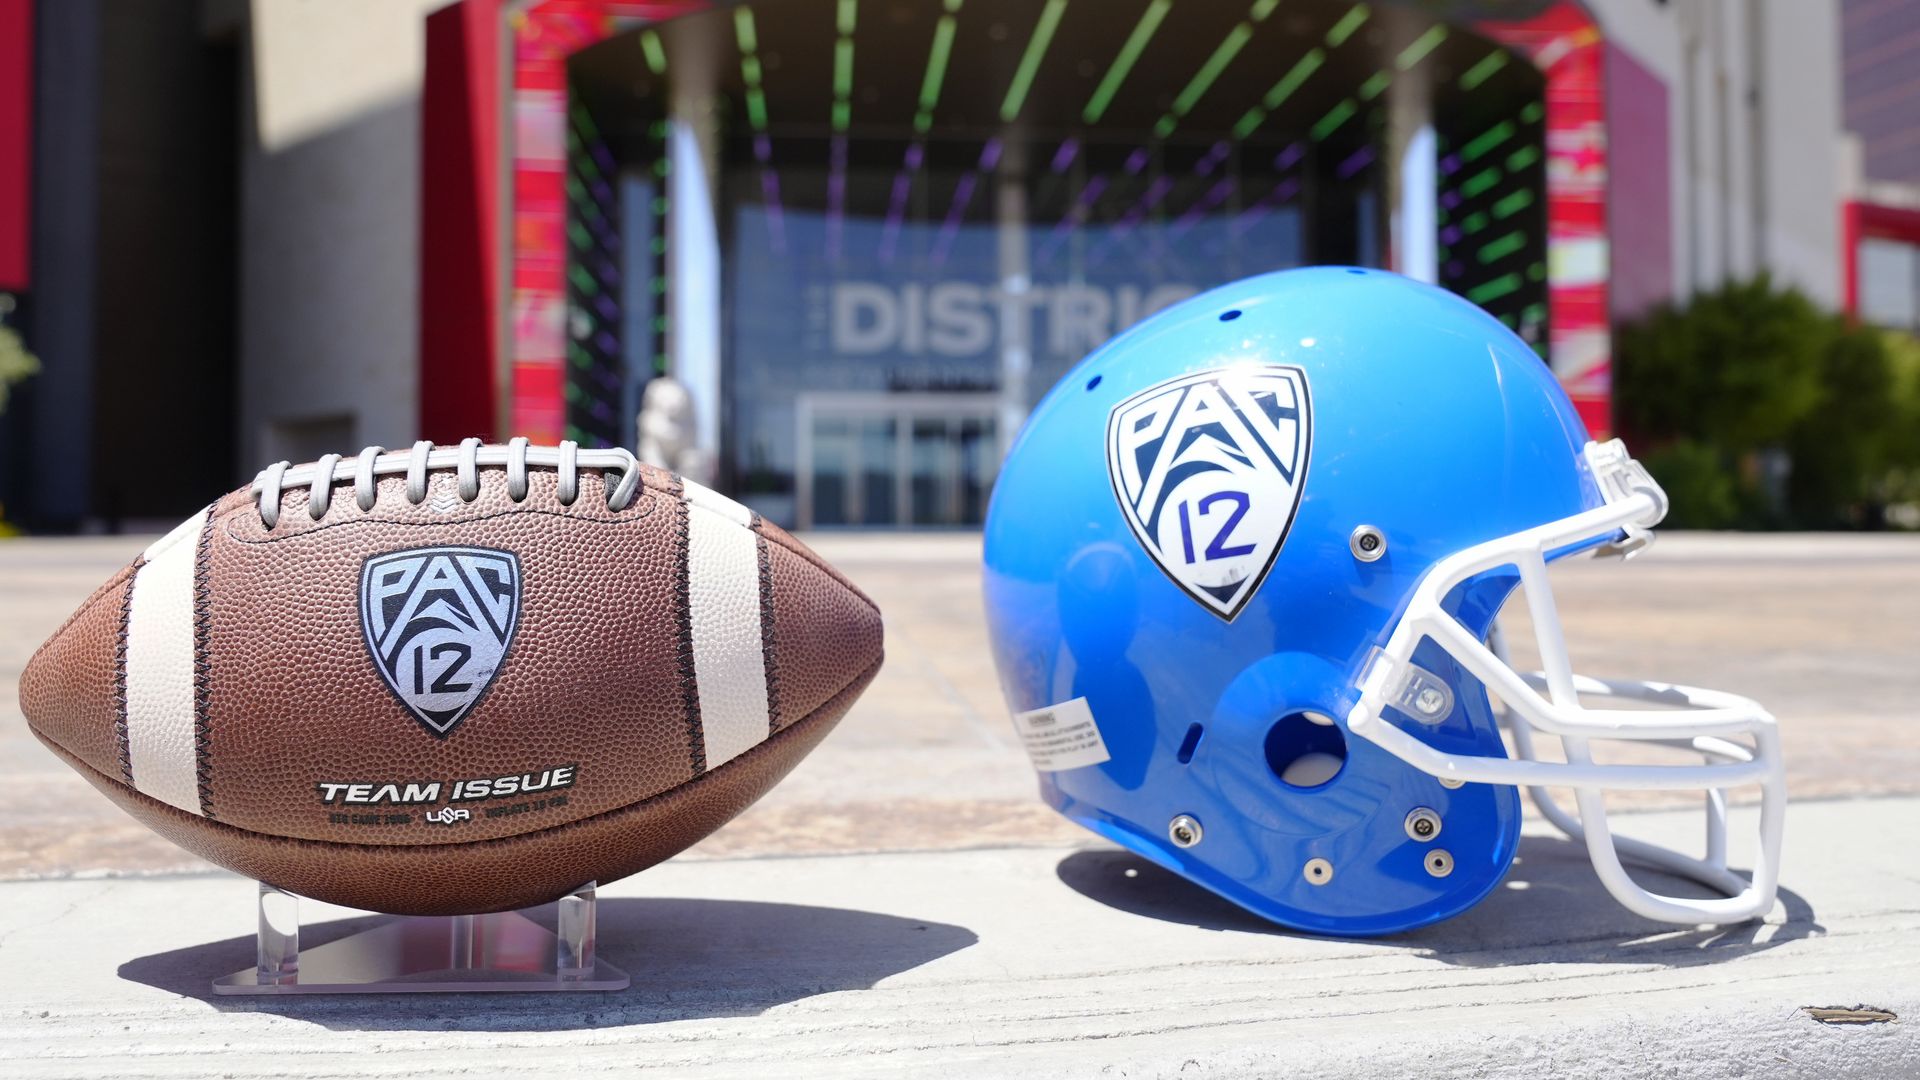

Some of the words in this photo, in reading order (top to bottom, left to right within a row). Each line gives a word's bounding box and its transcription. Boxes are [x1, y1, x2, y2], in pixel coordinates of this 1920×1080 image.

[1117, 374, 1297, 527] PAC
[1178, 490, 1257, 565] 12
[370, 555, 511, 662] PAC
[414, 642, 473, 695] 12
[319, 783, 441, 803] TEAM
[451, 766, 574, 799] ISSUE
[426, 807, 469, 825] USA
